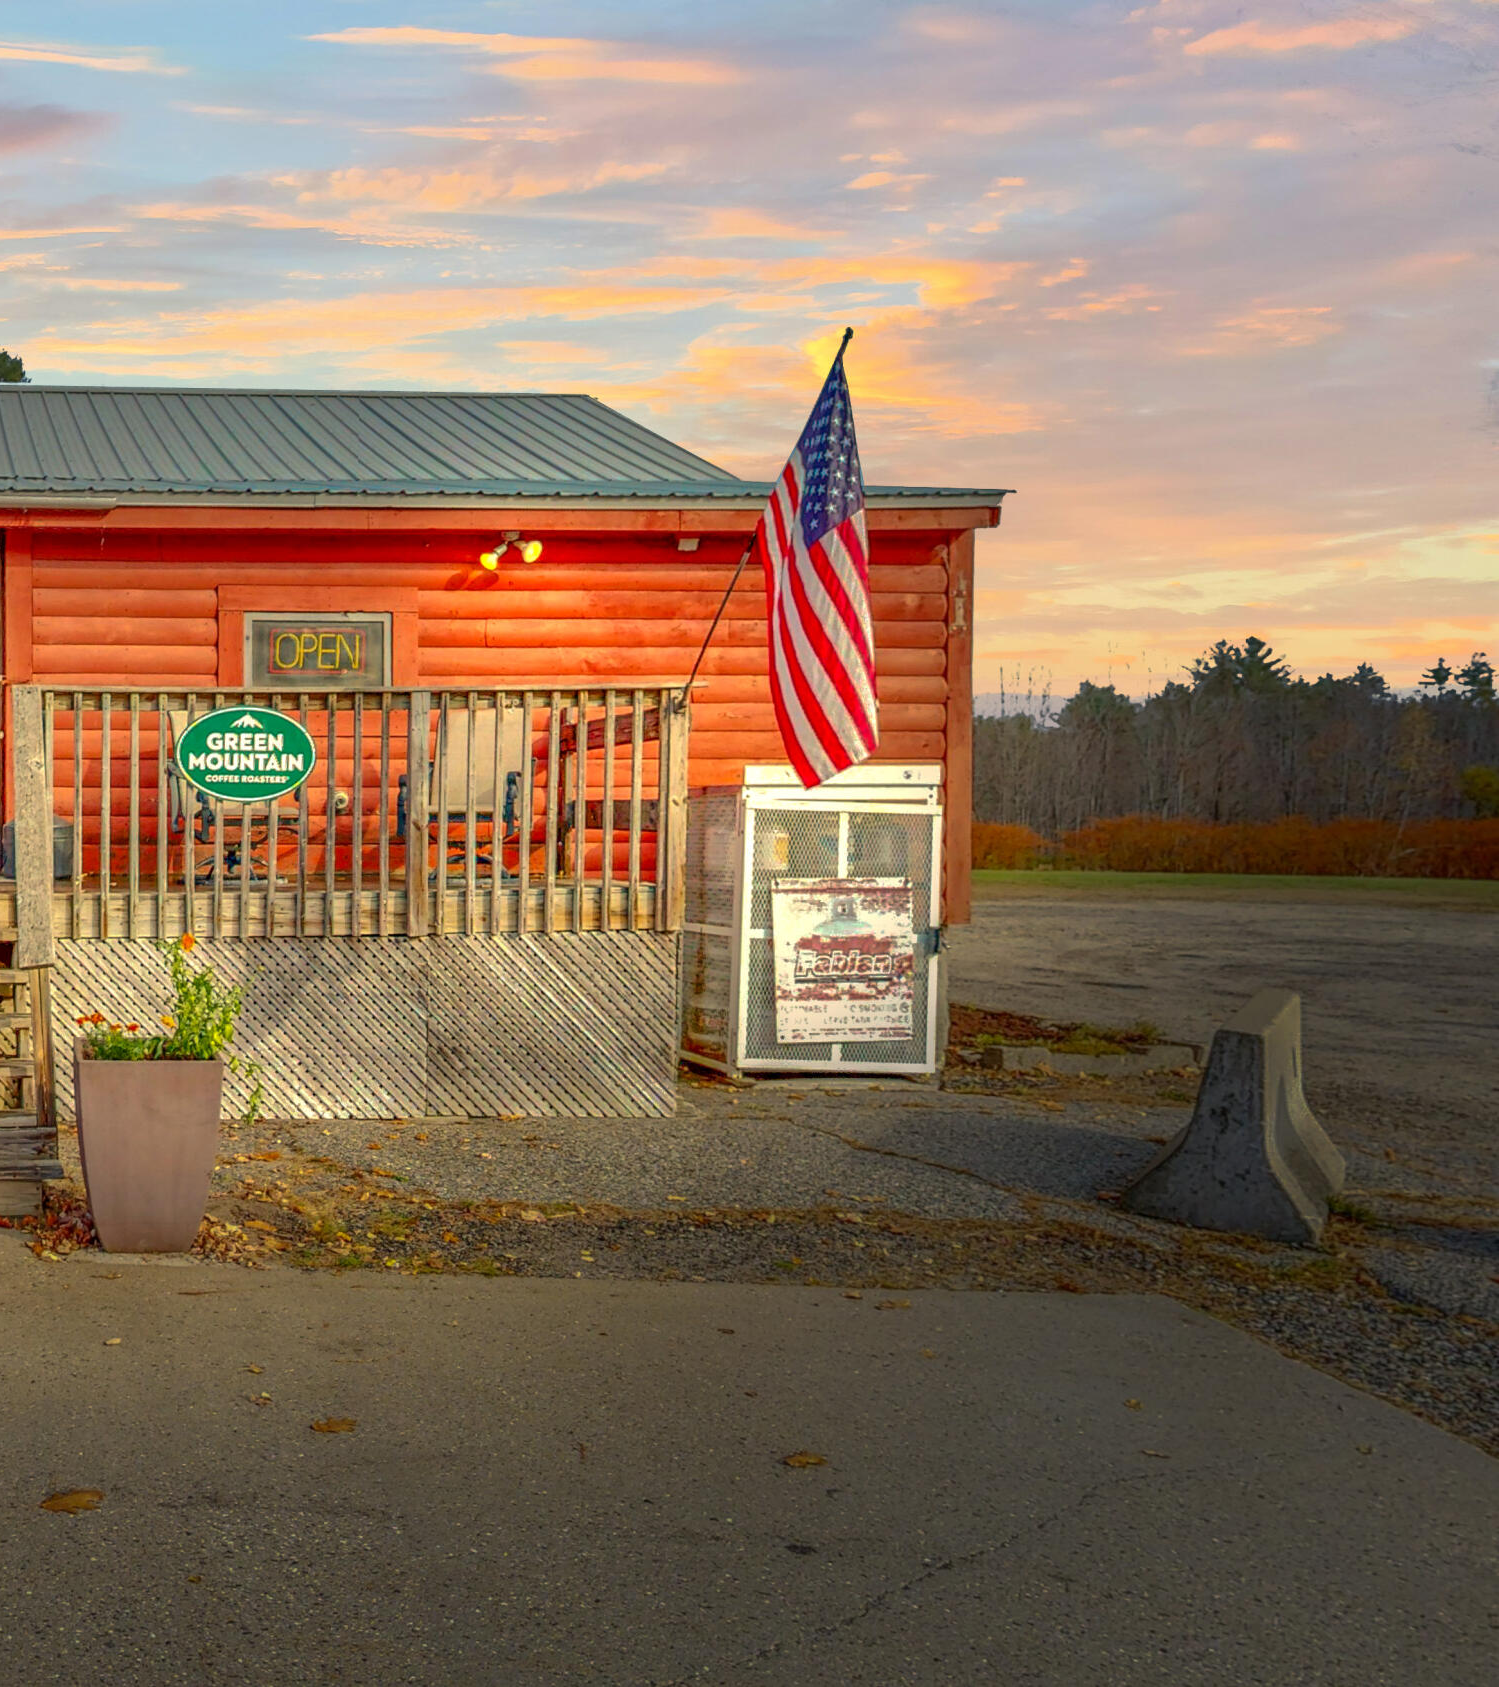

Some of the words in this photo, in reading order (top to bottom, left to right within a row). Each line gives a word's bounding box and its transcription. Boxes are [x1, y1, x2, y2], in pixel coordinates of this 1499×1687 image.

[274, 632, 360, 669] OPEN
[206, 732, 284, 752] GREEN
[187, 752, 304, 772] MOUNTAIN
[204, 774, 240, 783] COFFEE
